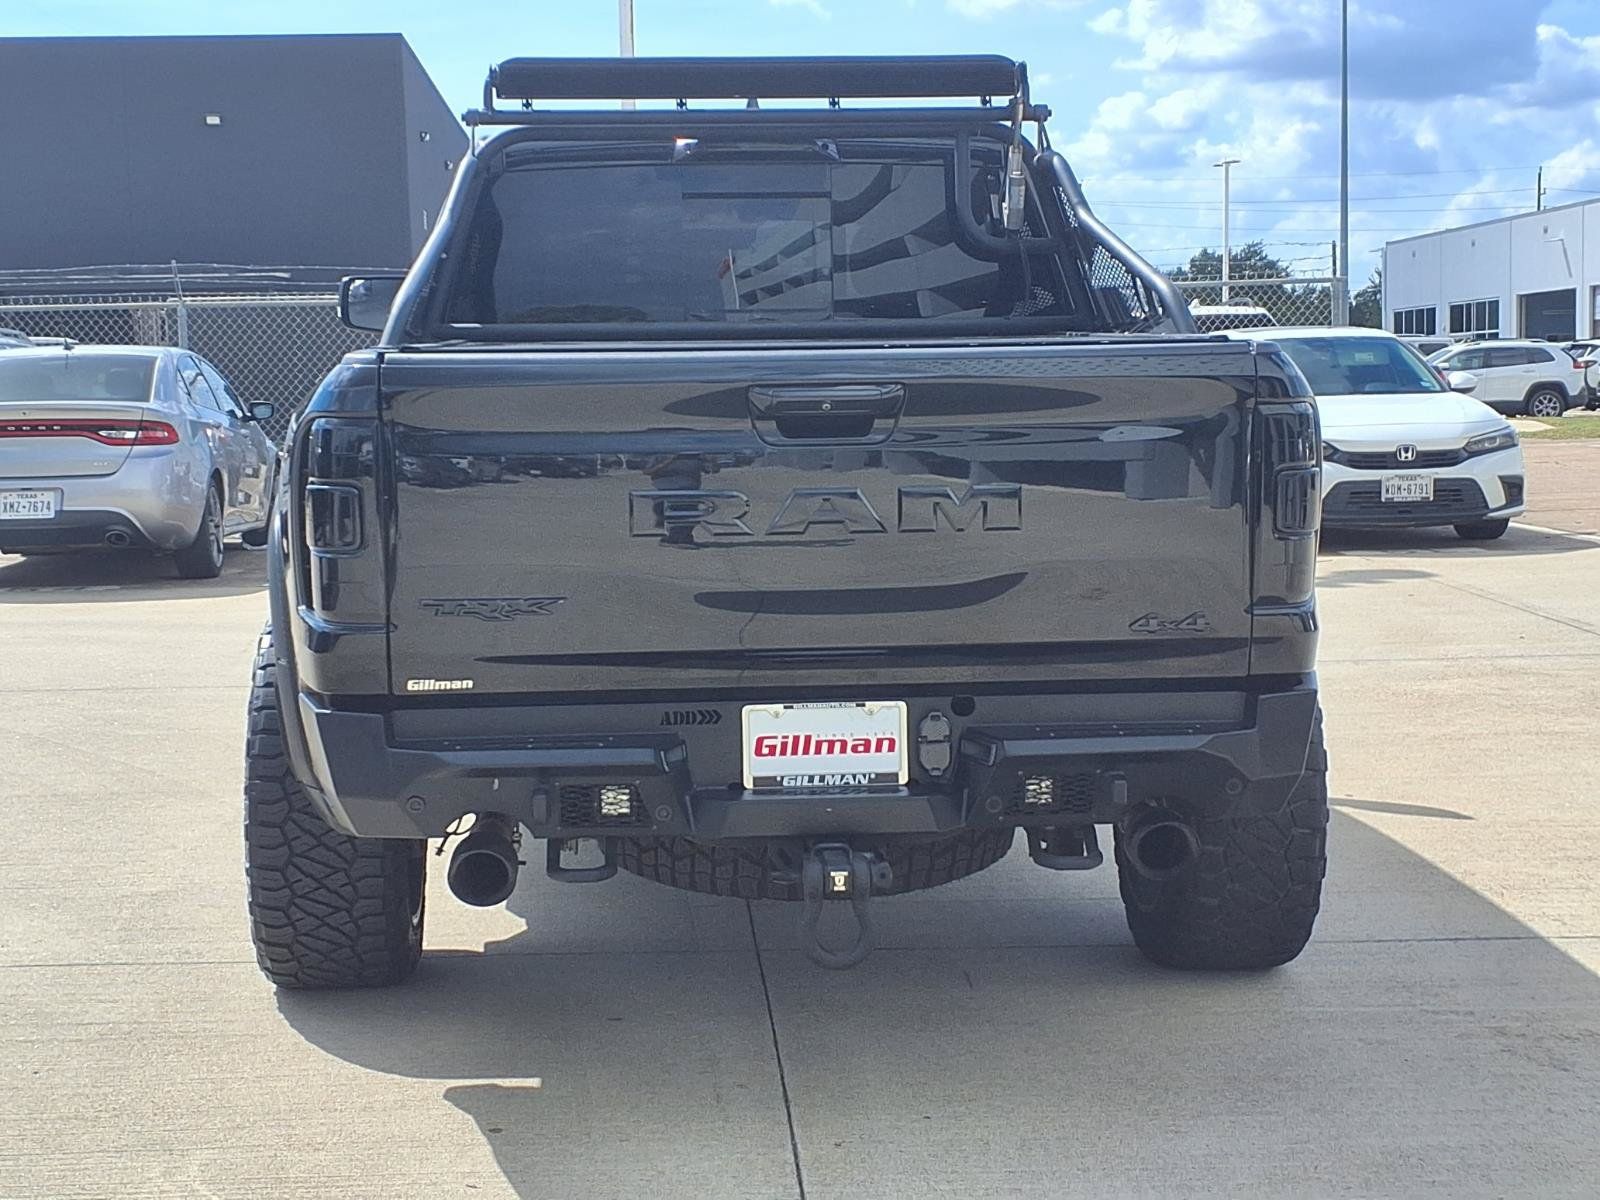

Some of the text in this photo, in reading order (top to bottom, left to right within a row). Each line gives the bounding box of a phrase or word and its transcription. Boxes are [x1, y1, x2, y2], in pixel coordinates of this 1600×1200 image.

[629, 484, 1023, 538] RAM
[406, 678, 474, 692] Gillman
[754, 735, 896, 757] Gillman
[783, 774, 869, 786] GILLMAN
